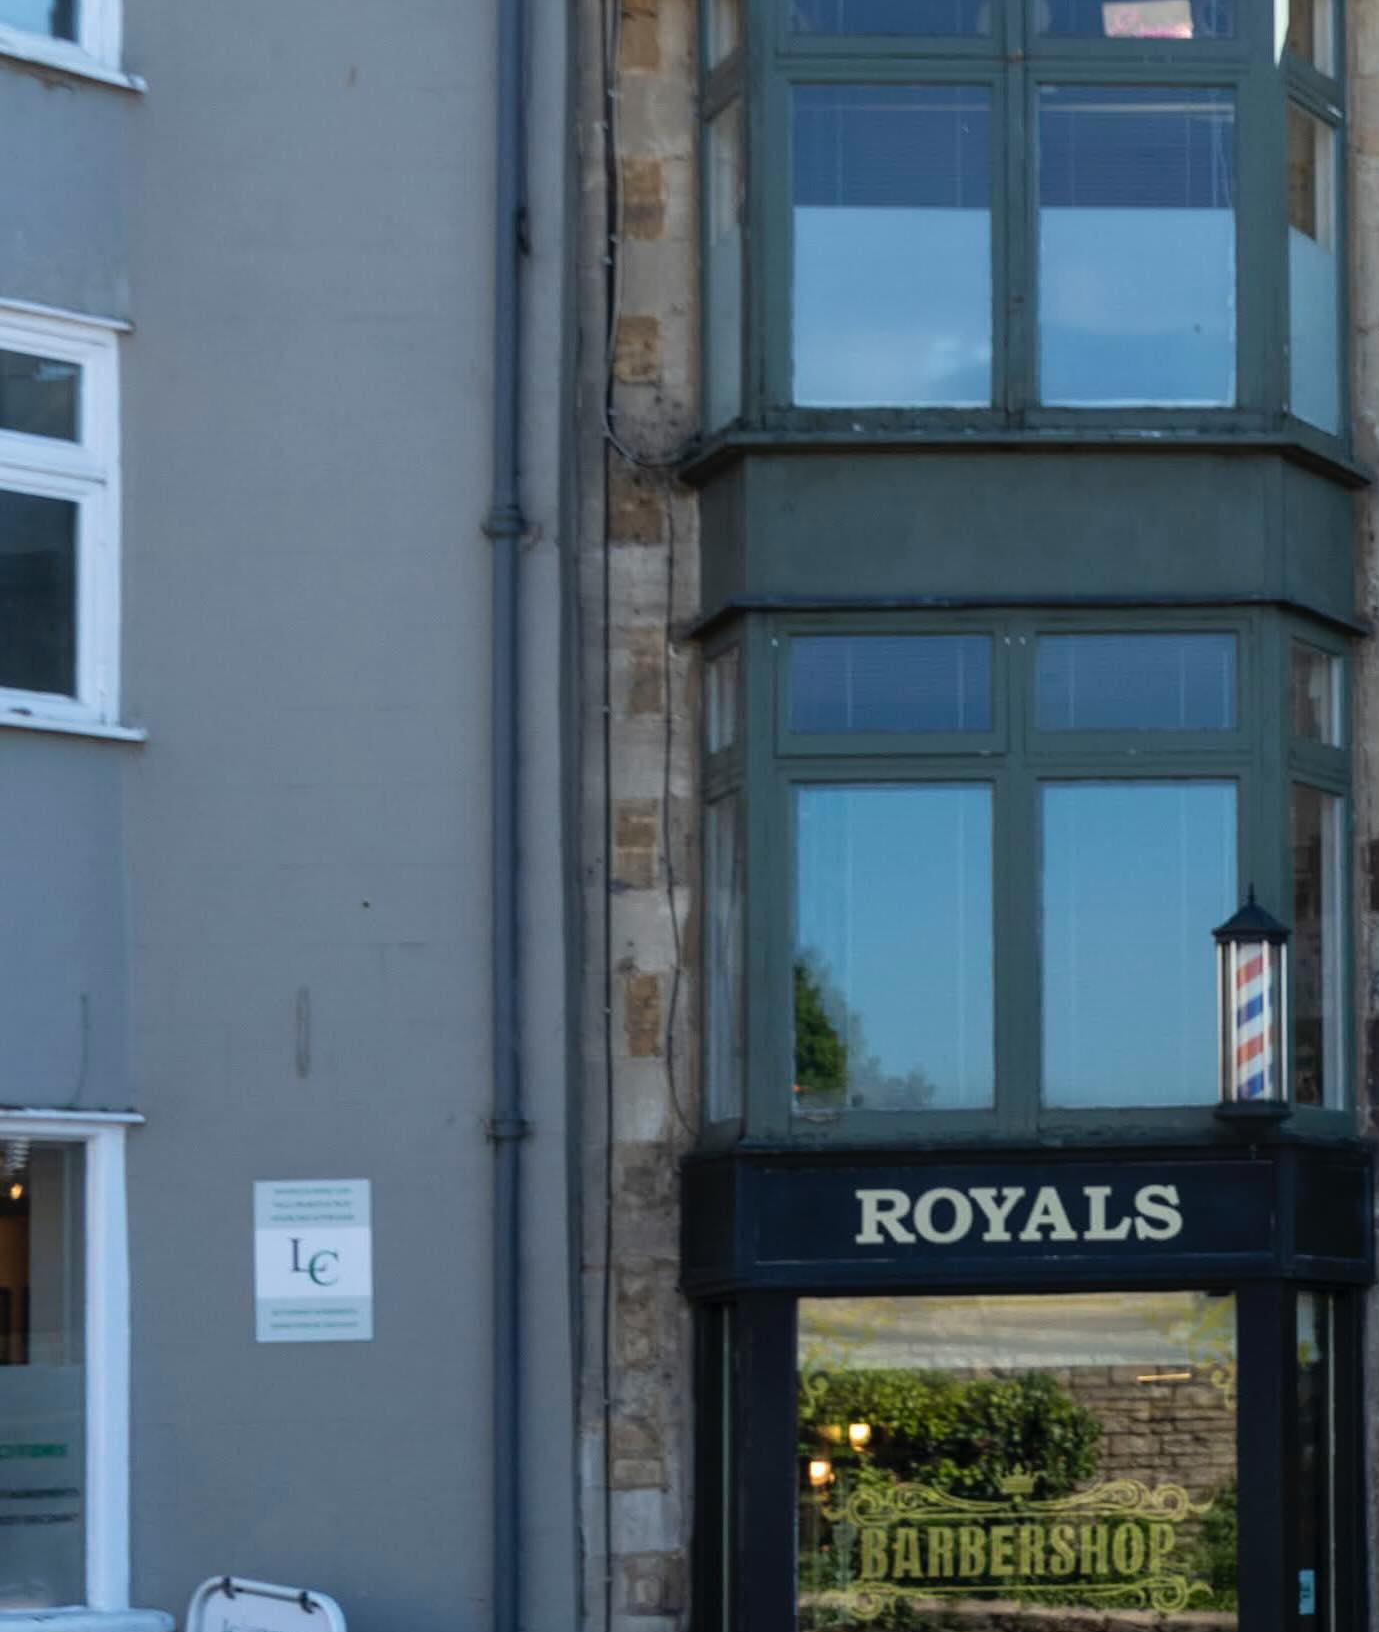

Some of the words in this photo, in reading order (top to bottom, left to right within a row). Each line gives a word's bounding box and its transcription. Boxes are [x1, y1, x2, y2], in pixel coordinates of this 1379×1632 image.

[854, 1184, 1184, 1244] ROYALS
[287, 1237, 339, 1287] LC
[860, 1520, 1177, 1579] BARBERSHOP
